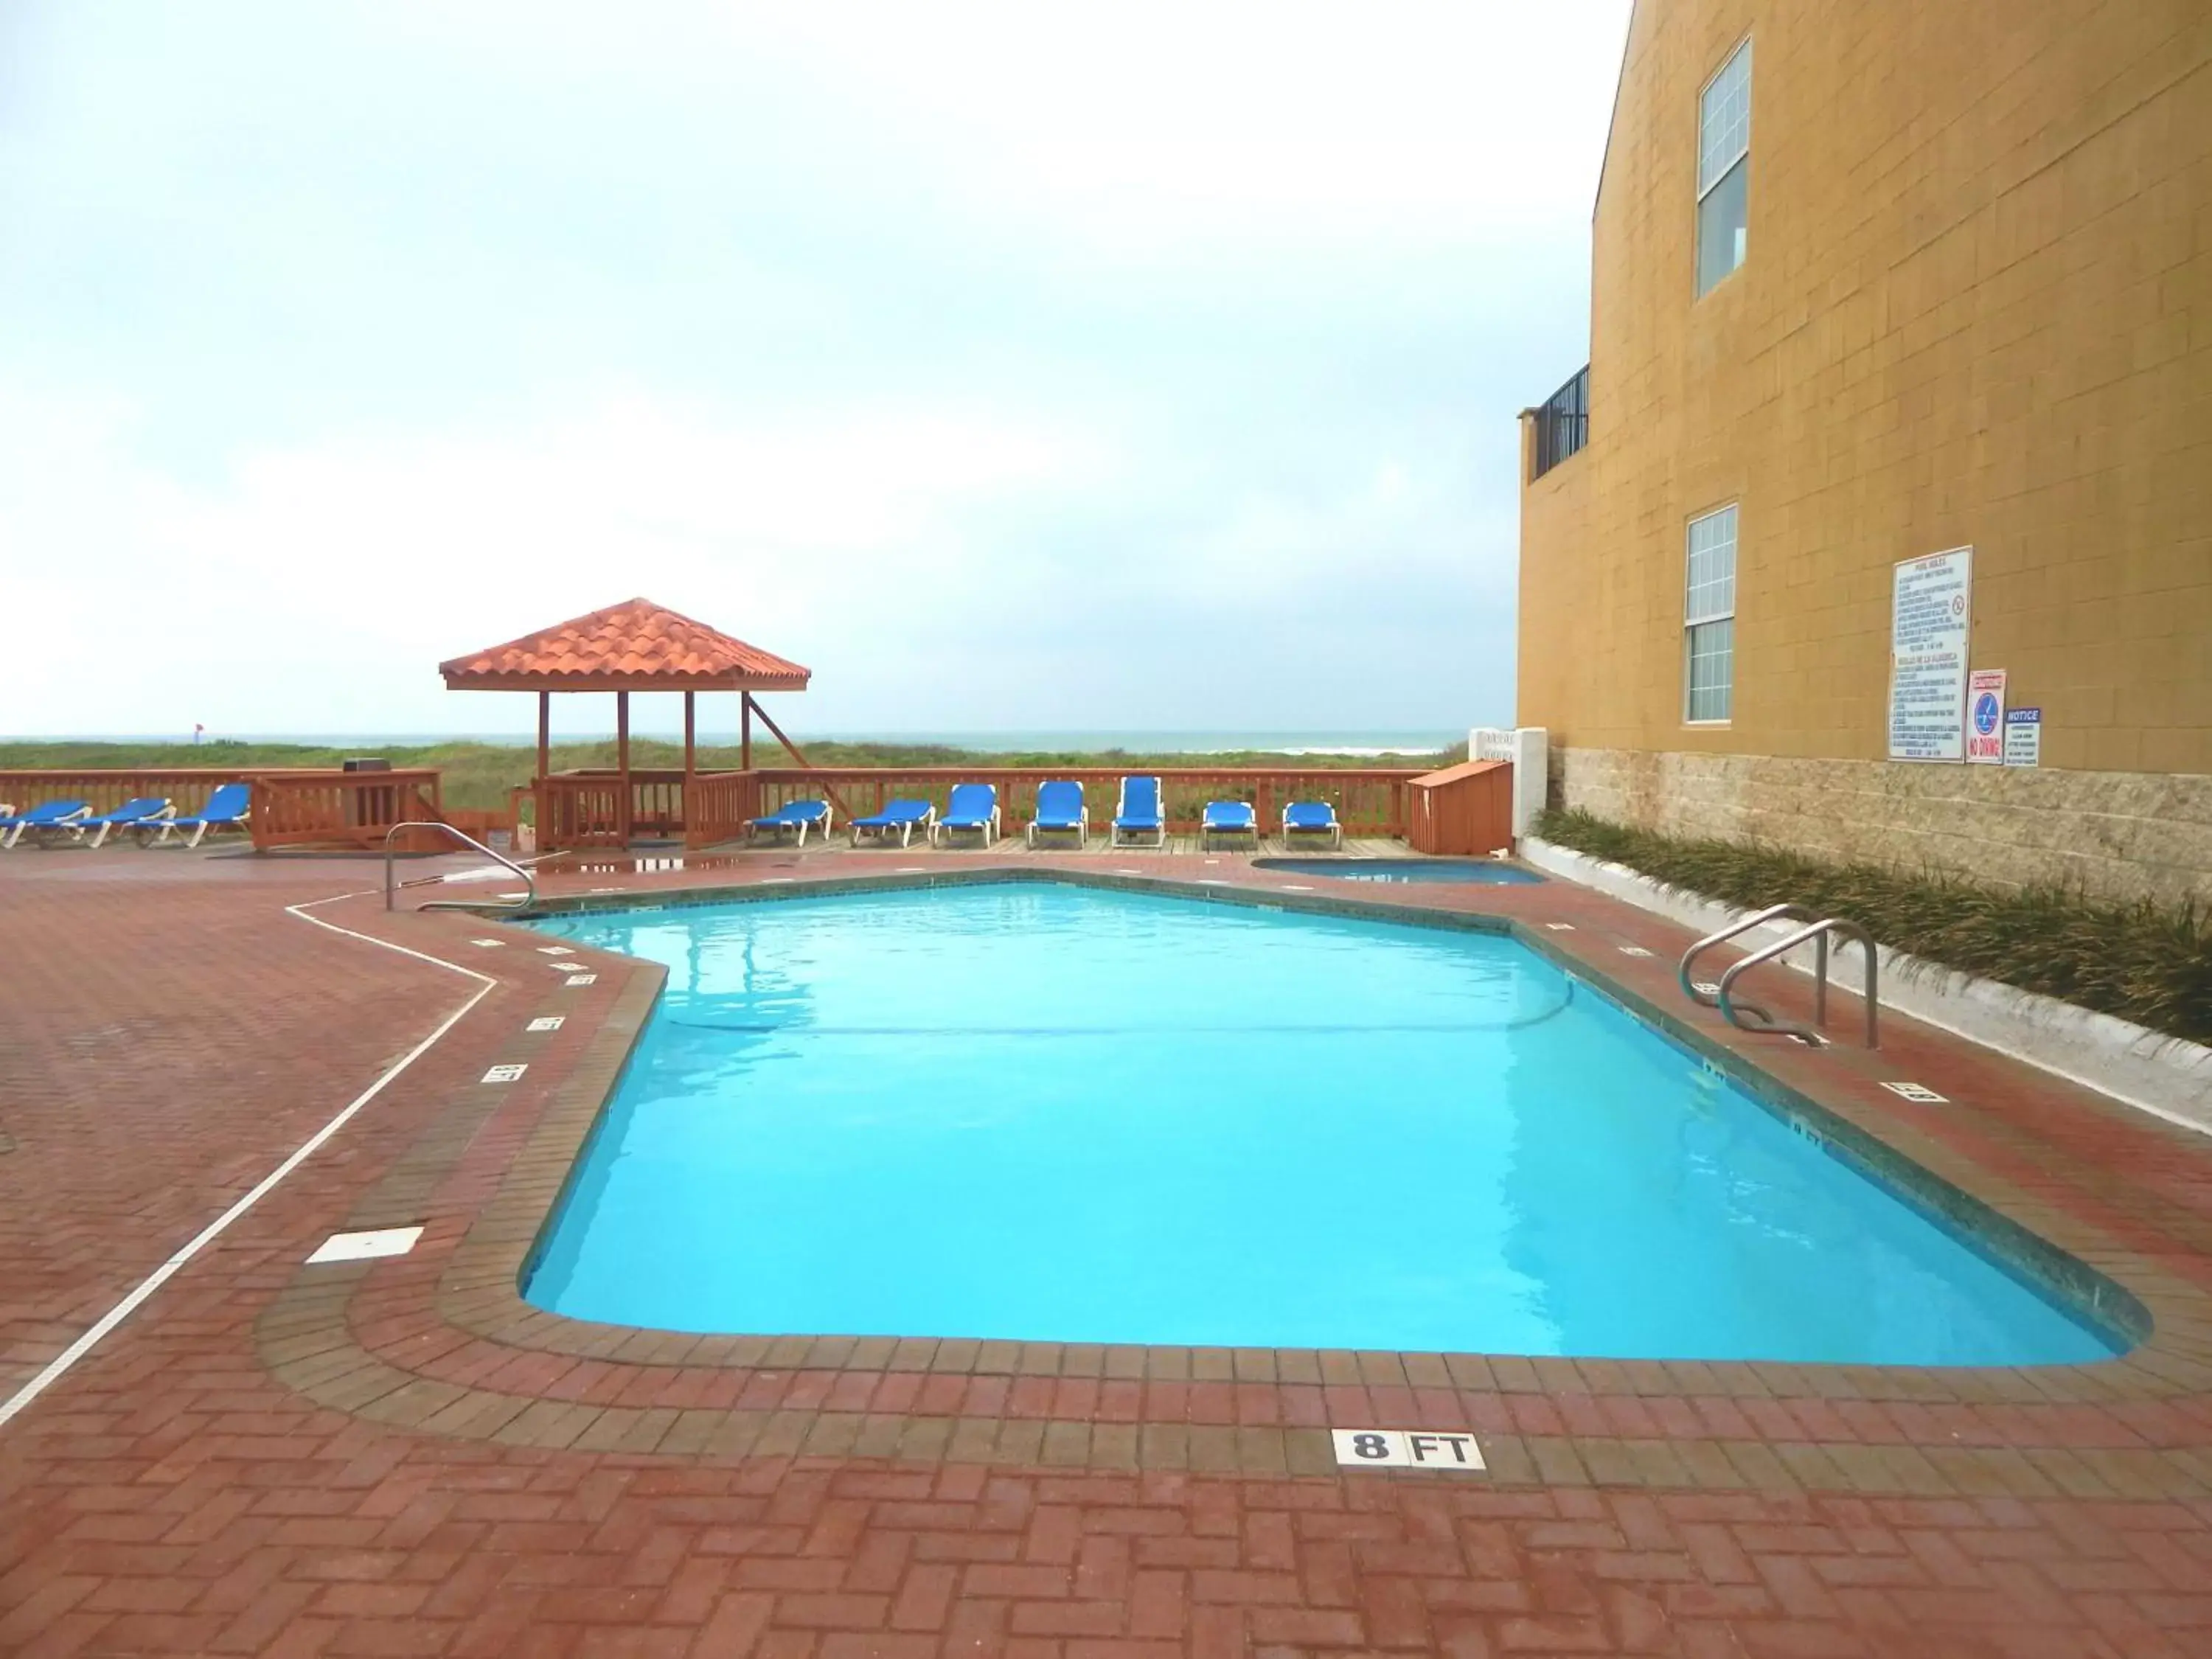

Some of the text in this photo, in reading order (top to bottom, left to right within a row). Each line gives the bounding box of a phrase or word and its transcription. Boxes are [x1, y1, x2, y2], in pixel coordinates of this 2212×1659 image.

[2007, 709, 2039, 720] NOTICE
[1969, 737, 1978, 757] NO
[1353, 1433, 1470, 1463] 8 FT
